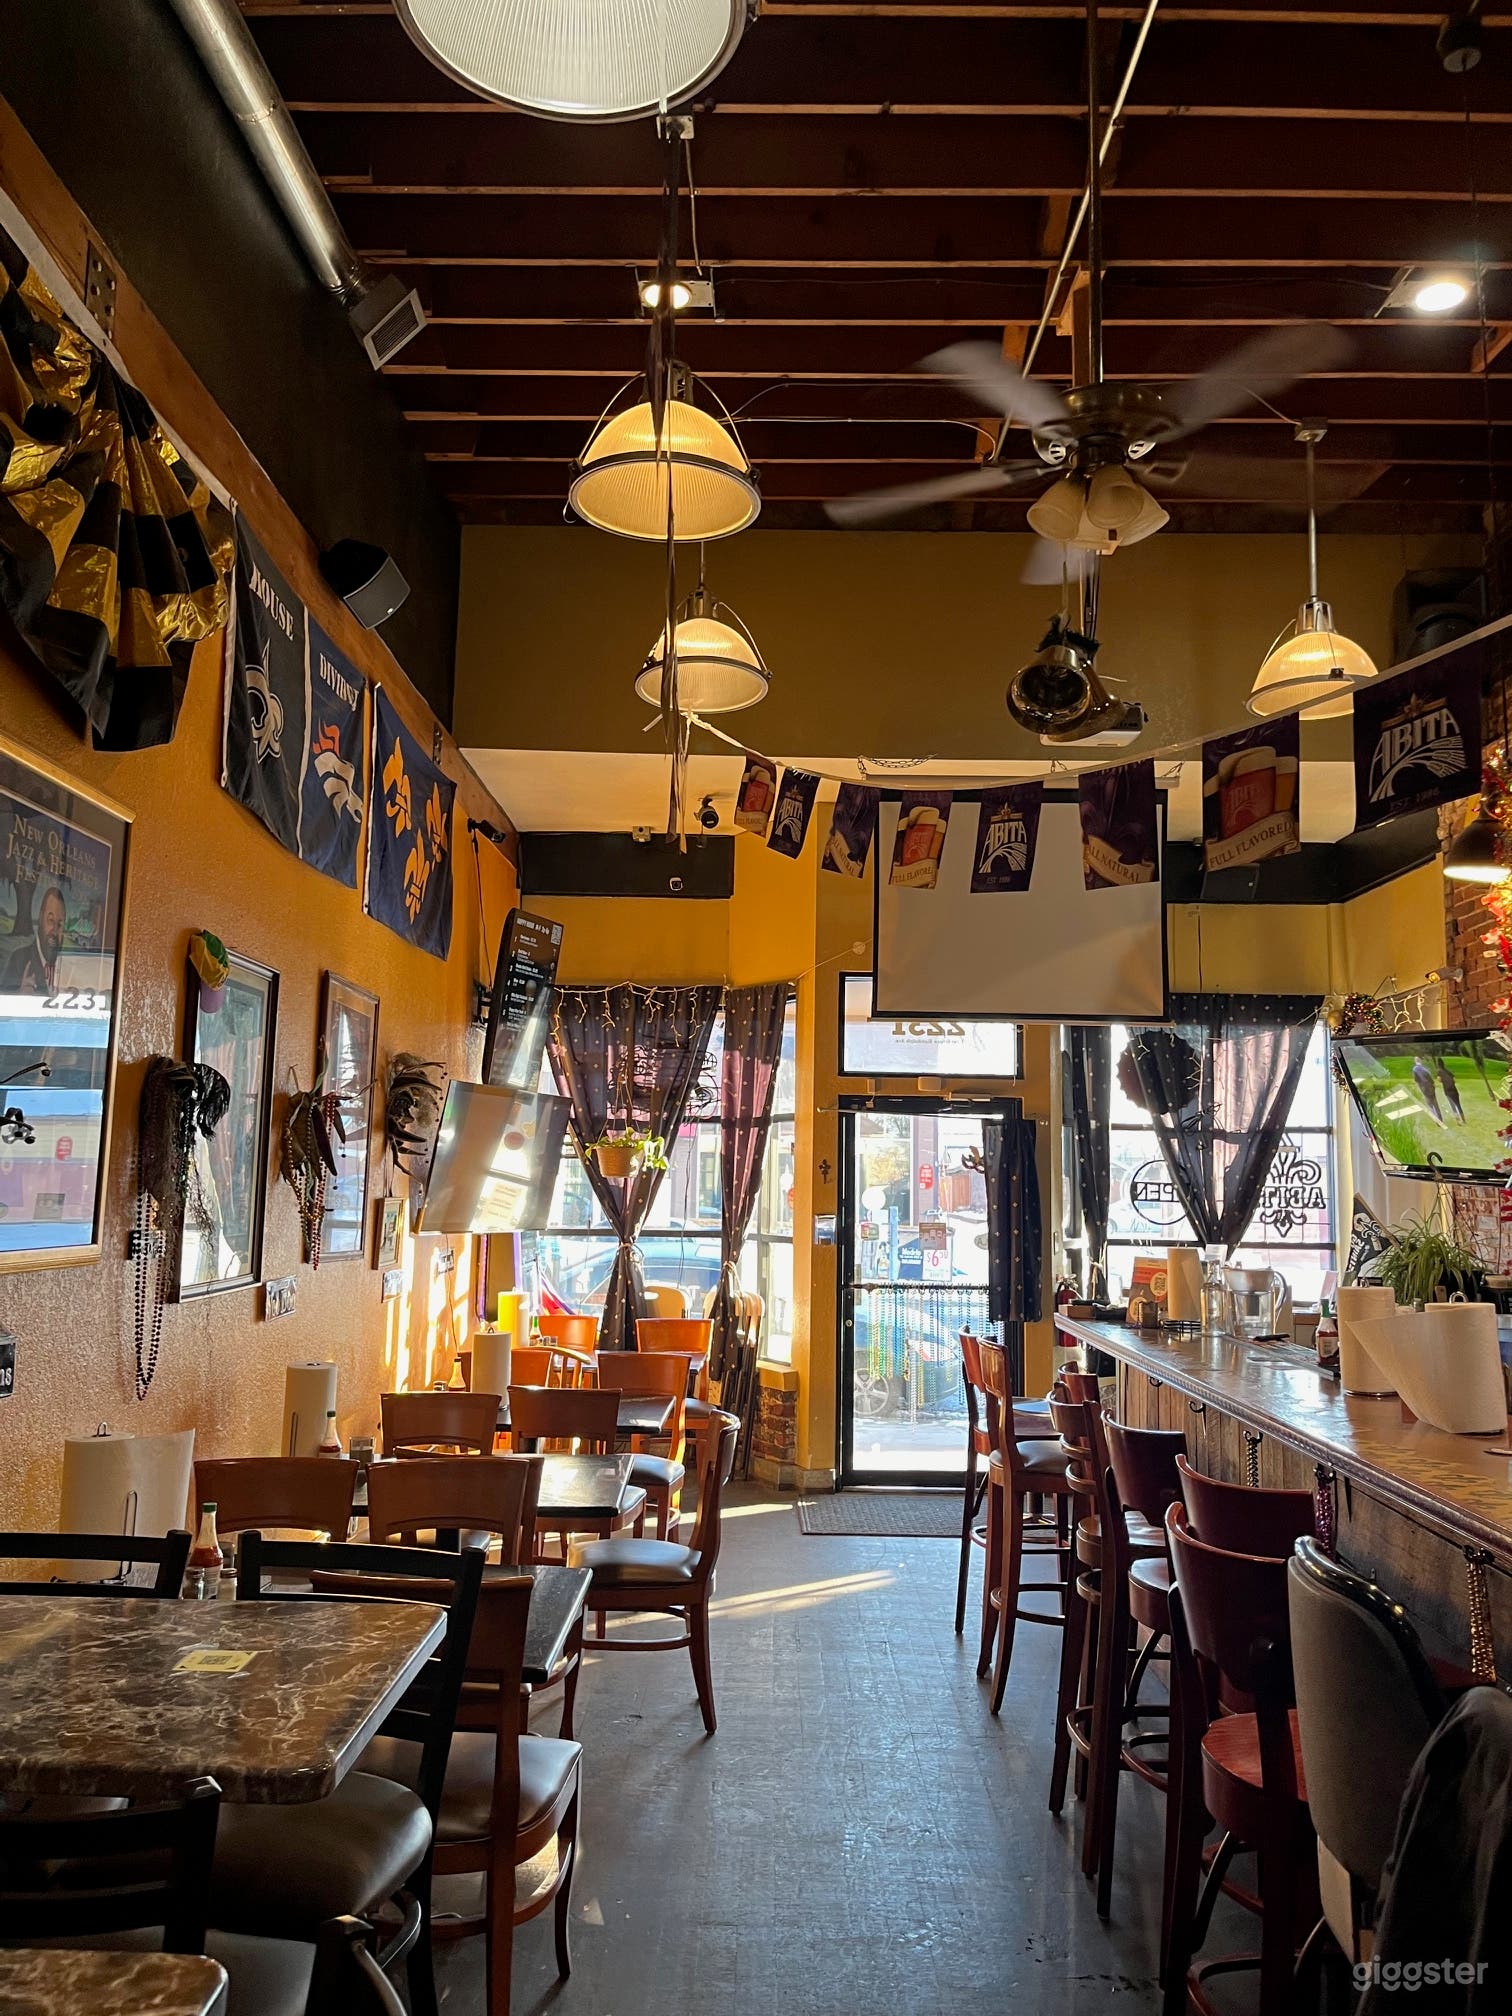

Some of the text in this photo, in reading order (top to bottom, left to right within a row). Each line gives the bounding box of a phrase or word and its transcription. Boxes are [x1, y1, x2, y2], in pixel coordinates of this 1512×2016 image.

[249, 561, 294, 642] HOUSE
[1369, 708, 1460, 797] ABITA
[13, 814, 44, 844] NEW
[776, 798, 803, 829] ABITA
[6, 833, 34, 862] JAZZ
[979, 820, 1027, 868] ABITA
[1209, 821, 1293, 868] FULL FLAVORED
[42, 986, 112, 1011] 2231
